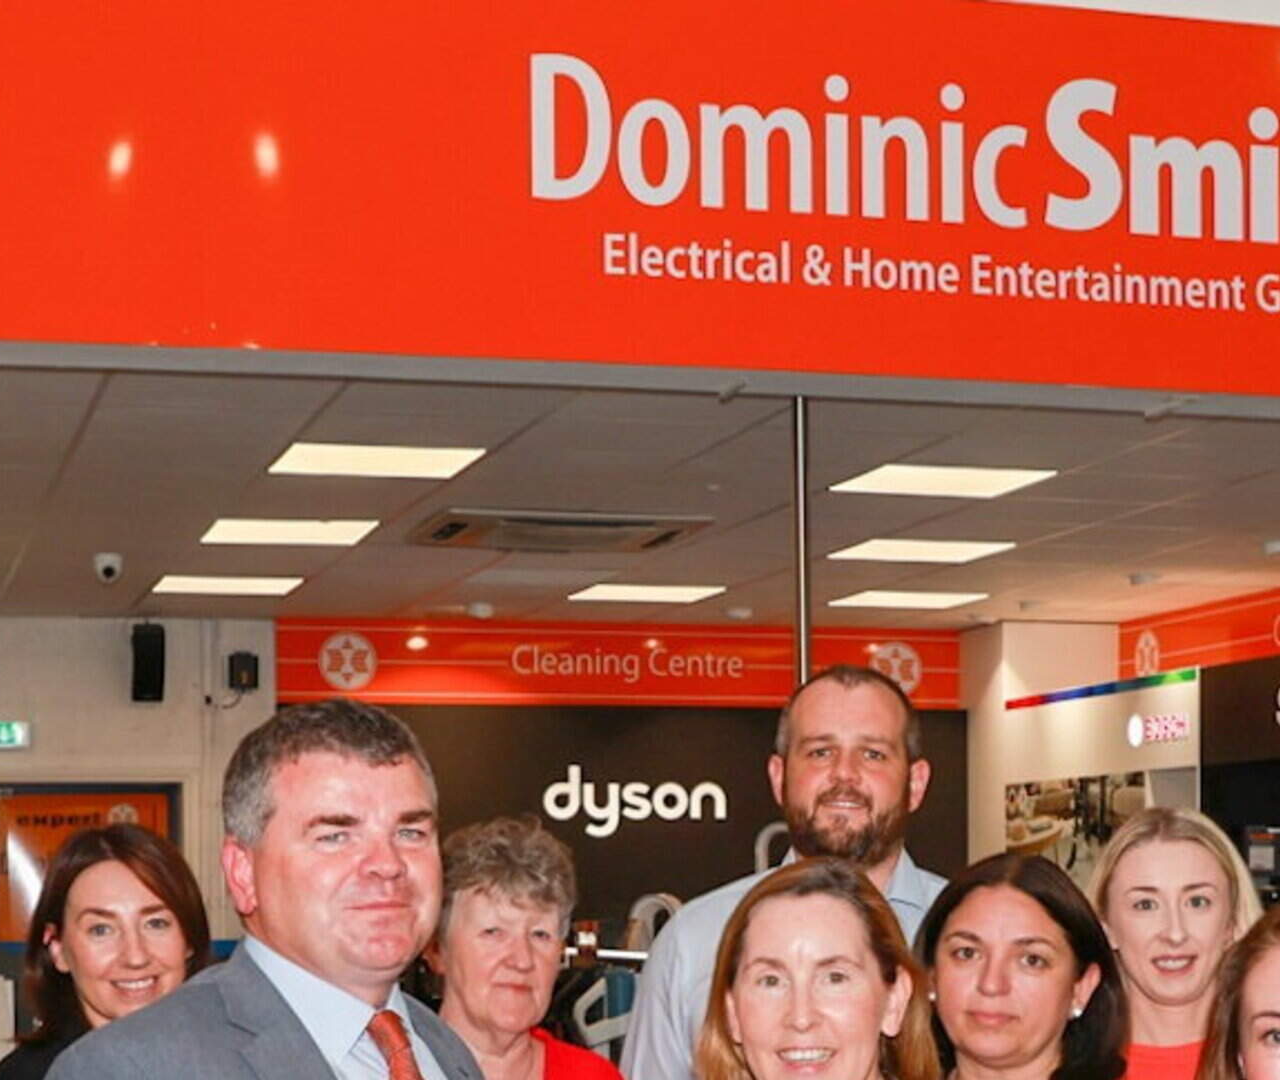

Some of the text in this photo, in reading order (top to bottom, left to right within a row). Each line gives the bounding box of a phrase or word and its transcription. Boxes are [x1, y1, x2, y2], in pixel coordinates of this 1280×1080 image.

[530, 53, 1027, 228] Dominic
[603, 232, 791, 284] Electrical
[802, 244, 832, 286] &
[843, 246, 961, 294] Home
[970, 253, 1246, 311] Entertainment
[511, 644, 744, 684] Cleaning Centre
[542, 763, 728, 838] dyson
